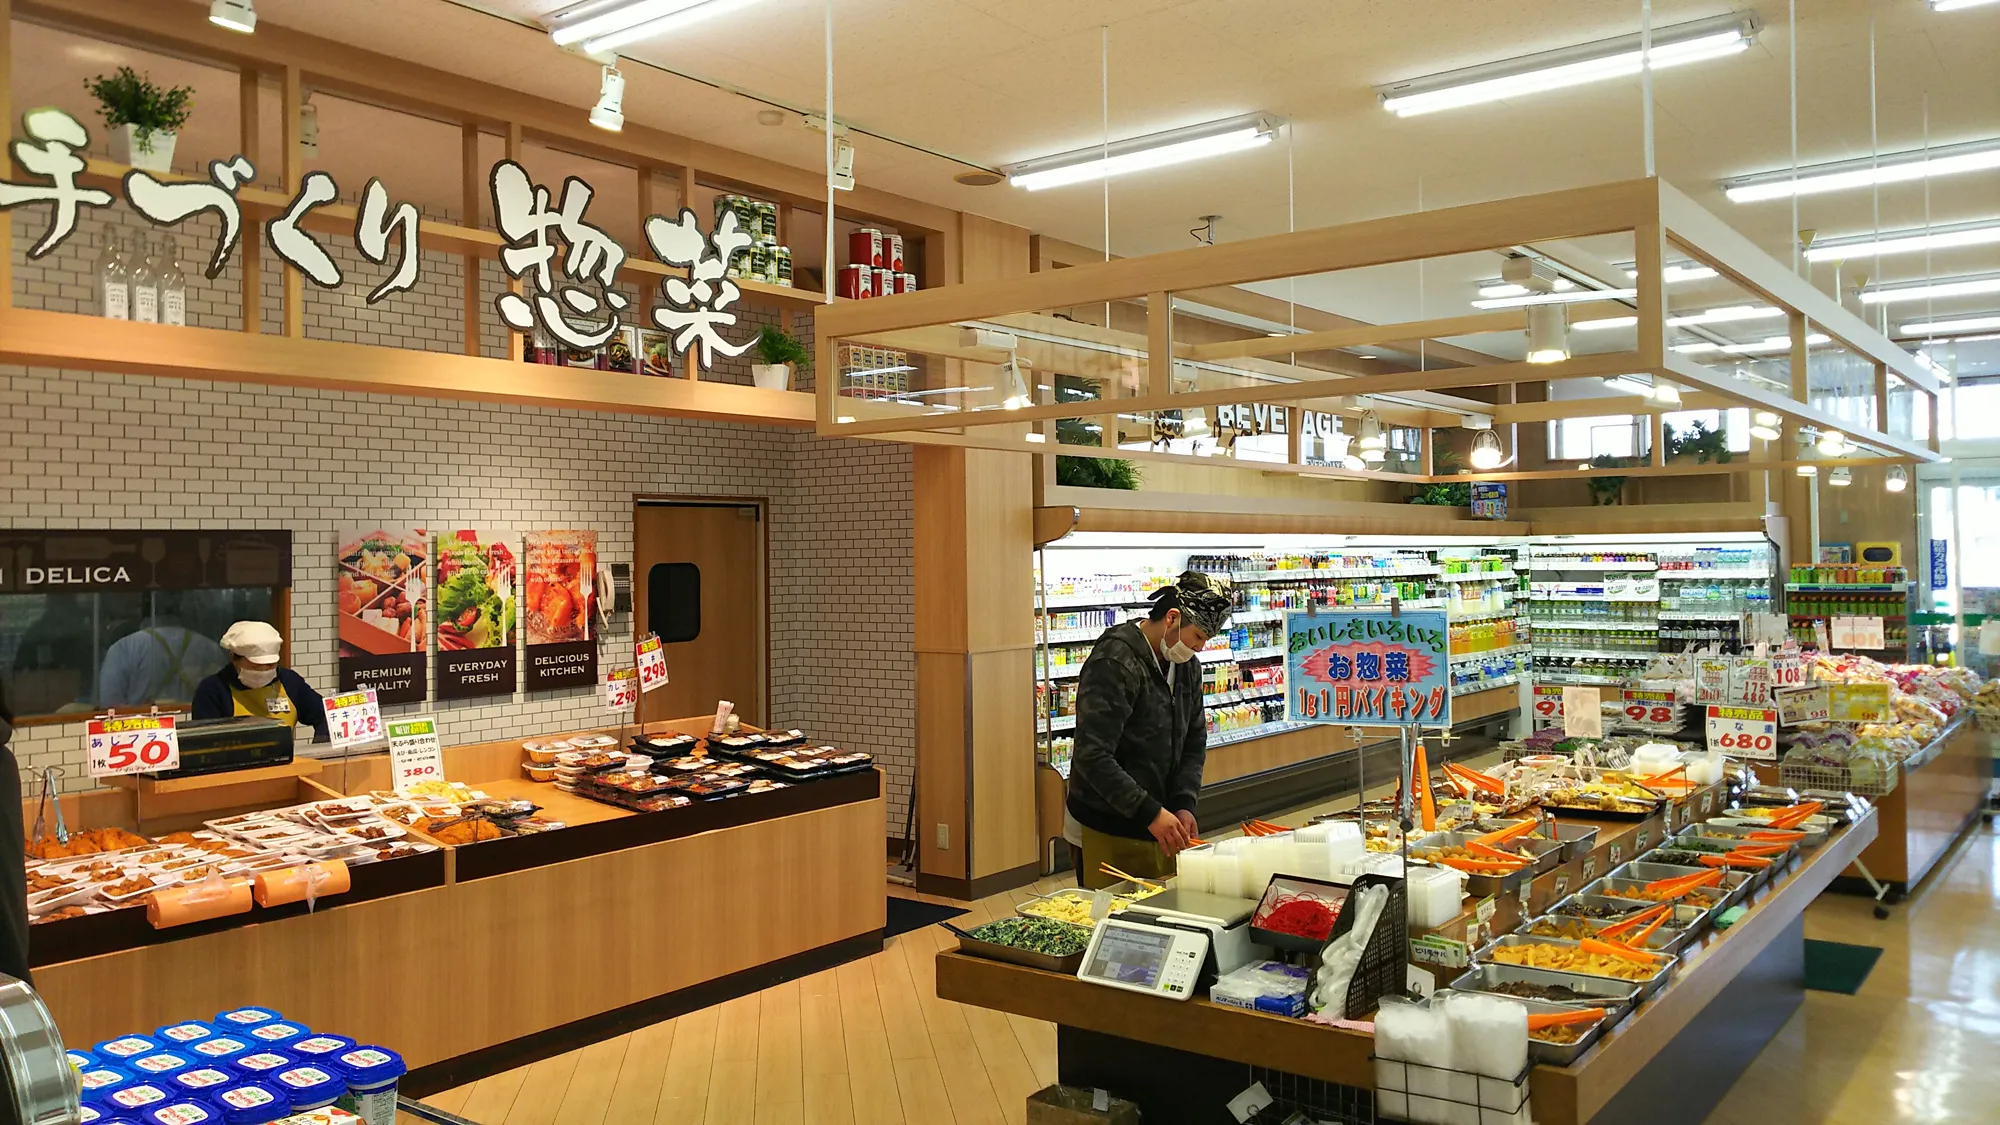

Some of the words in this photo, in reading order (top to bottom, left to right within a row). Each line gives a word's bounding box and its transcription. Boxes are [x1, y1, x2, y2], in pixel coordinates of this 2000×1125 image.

[1216, 403, 1343, 436] BEVEAGE
[26, 566, 131, 585] DELICA
[1289, 618, 1447, 653] おいしさいろいろ
[449, 659, 508, 673] EVERYDAY
[535, 653, 590, 666] DELICIOUS
[1328, 652, 1410, 681] お惣菜
[354, 666, 412, 680] PREMIUM
[461, 672, 499, 685] FRESH
[540, 665, 585, 678] KITCHEN
[643, 661, 666, 683] 298
[1776, 667, 1800, 684] 108
[357, 679, 412, 692] UALITY
[1744, 681, 1766, 693] 175
[615, 689, 636, 706] 298
[1299, 684, 1445, 719] 1g1円バイキング
[1625, 706, 1672, 722] 98
[1719, 707, 1764, 720] 特売品
[1810, 709, 1828, 719] 98
[103, 718, 160, 732] 特売品
[341, 716, 378, 738] 128
[1710, 720, 1773, 734] うな重
[92, 732, 173, 749] あじフライ
[1720, 733, 1772, 751] 680
[108, 740, 170, 769] 50
[404, 766, 435, 778] 380
